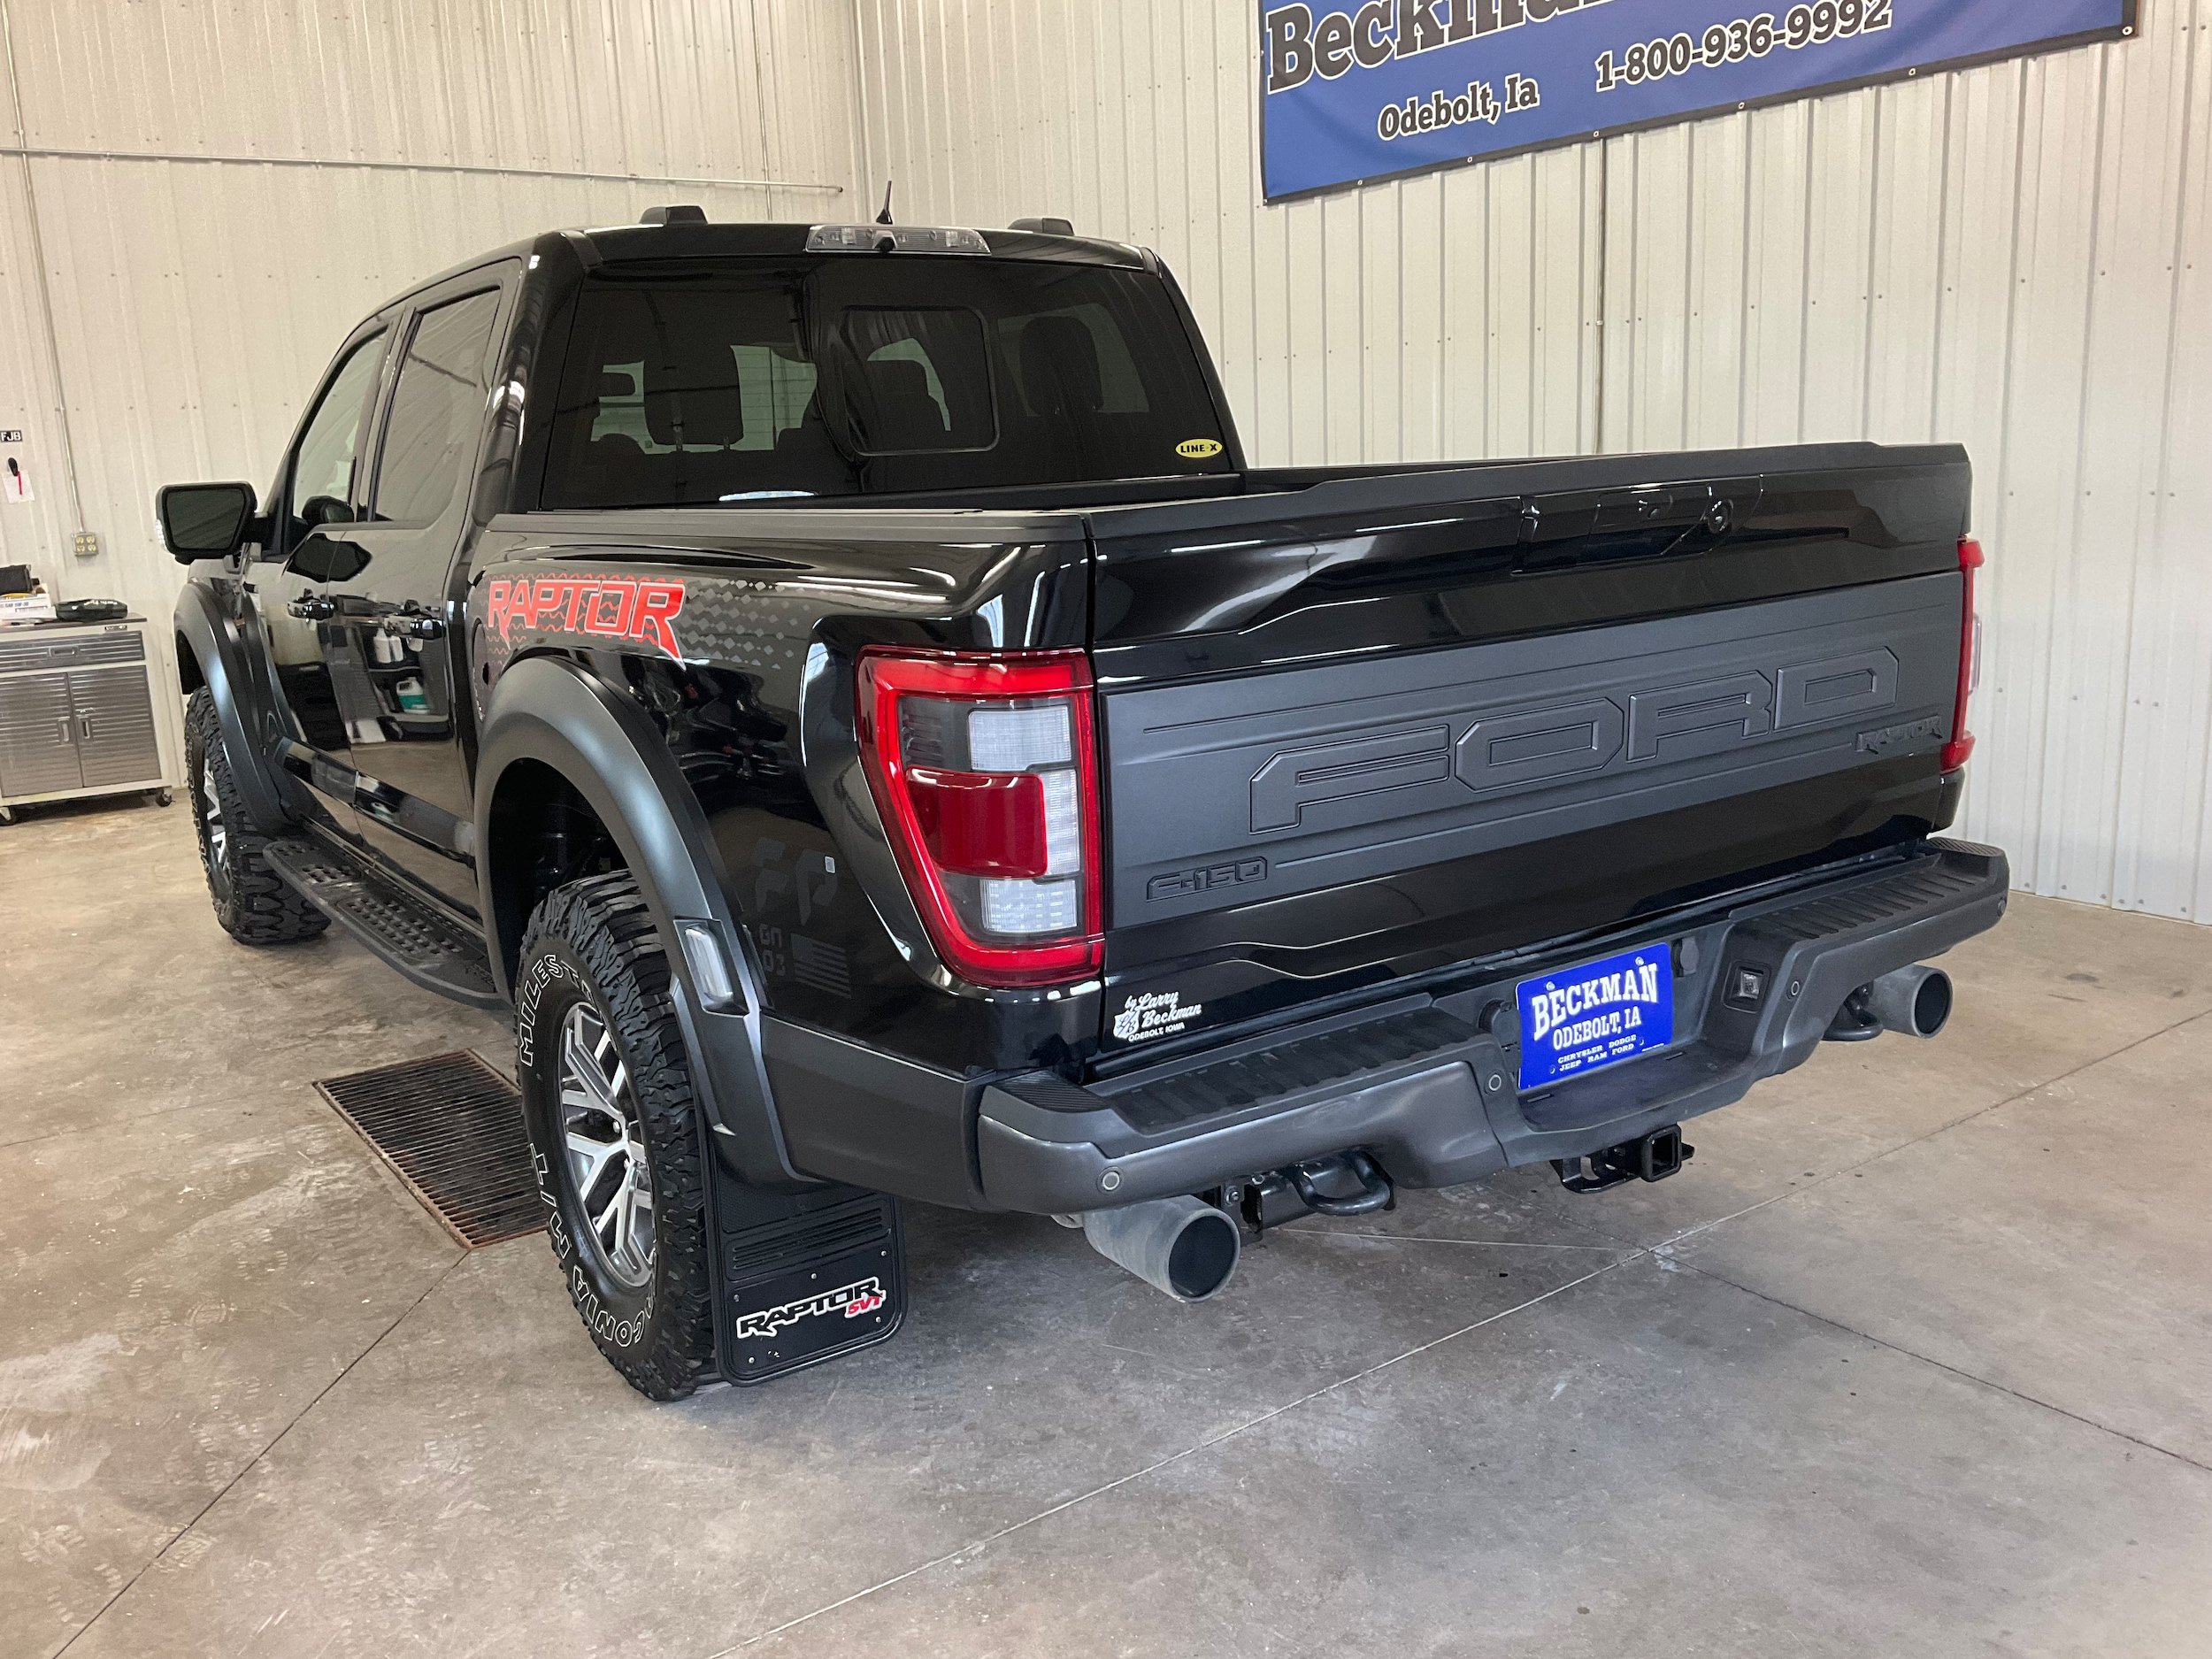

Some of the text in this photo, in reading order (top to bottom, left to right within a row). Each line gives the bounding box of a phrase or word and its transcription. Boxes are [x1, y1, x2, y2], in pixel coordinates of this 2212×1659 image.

[1268, 0, 1616, 95] Beckm
[1595, 0, 1893, 92] 1-800-936-9992
[1379, 73, 1540, 141] Odebolt, Ia
[1, 431, 21, 442] FJB
[488, 580, 687, 672] RAPTOR
[1249, 645, 1899, 836] FORD
[1147, 856, 1268, 902] F-150
[1125, 992, 1179, 1011] by Larry
[1141, 1004, 1202, 1028] Beckman
[1532, 963, 1658, 1041] BECKMAN
[1165, 1022, 1185, 1033] IOWA
[1553, 1006, 1642, 1051] ODEBOLT, IA
[1558, 1034, 1637, 1064] CHRYSLER DODGE
[1559, 1044, 1635, 1072] JEEP RAM FORD
[736, 1277, 887, 1339] RAPTOR
[845, 1295, 881, 1318] SVT
